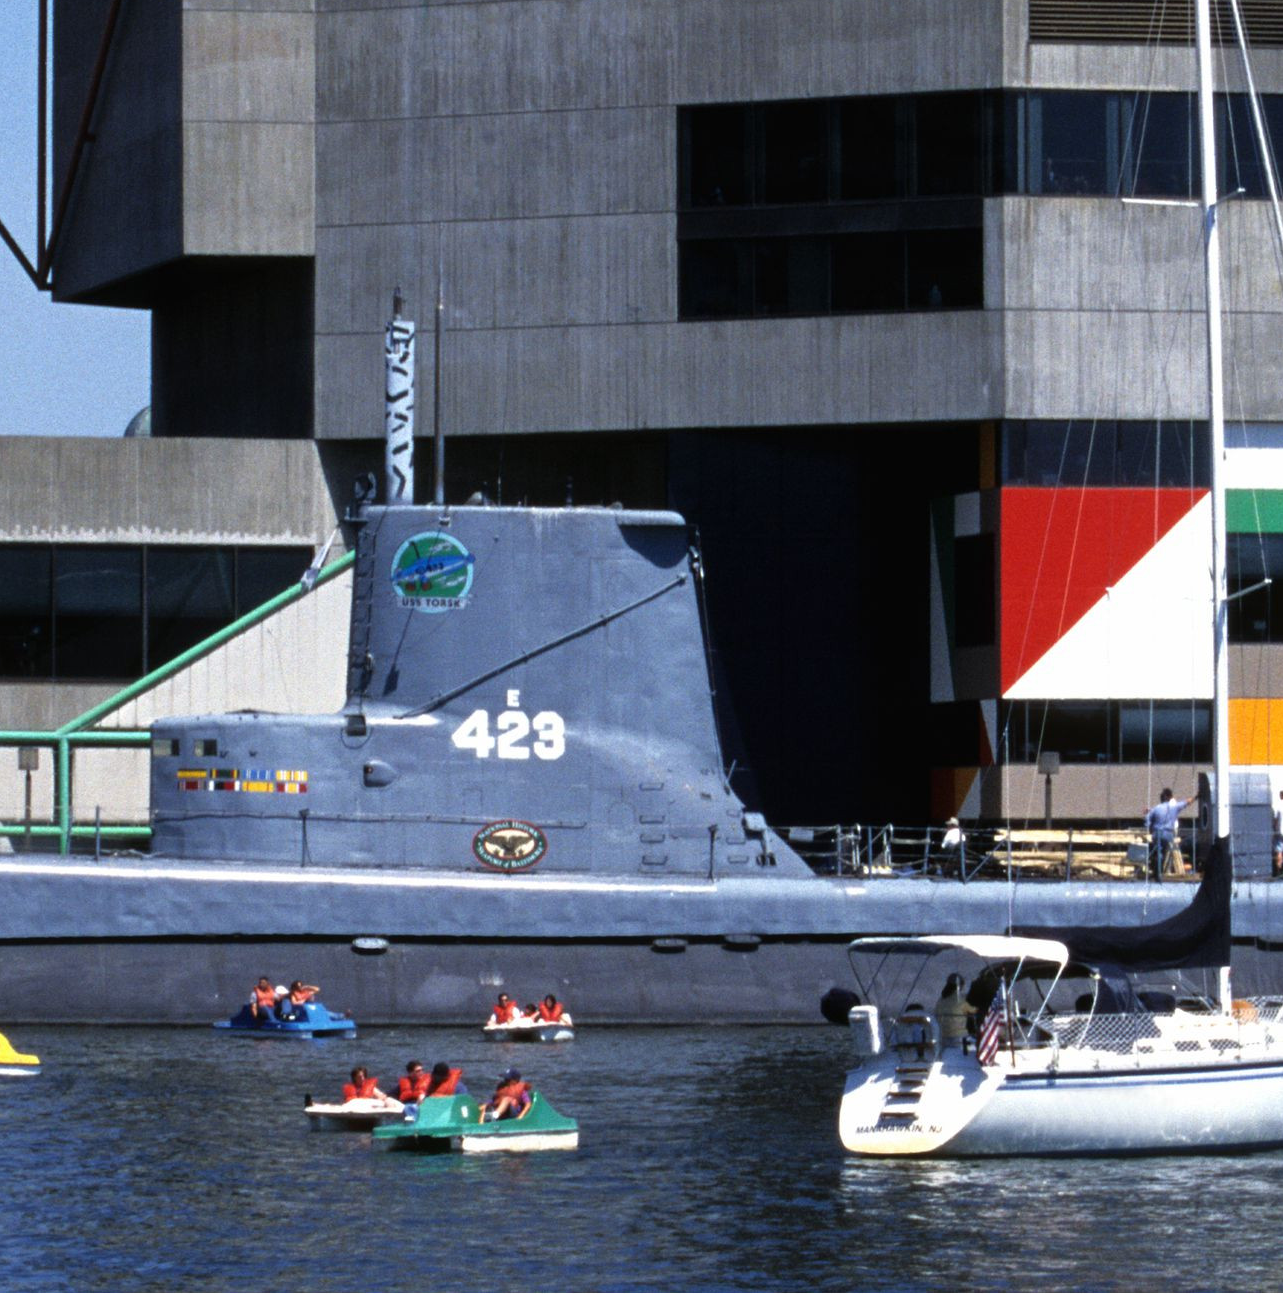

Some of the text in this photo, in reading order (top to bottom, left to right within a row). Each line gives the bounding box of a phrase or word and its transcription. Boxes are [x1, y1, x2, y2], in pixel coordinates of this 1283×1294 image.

[401, 597, 461, 608] USS TORSK
[507, 689, 520, 707] E
[451, 709, 566, 760] 423
[929, 1125, 942, 1133] NJ
